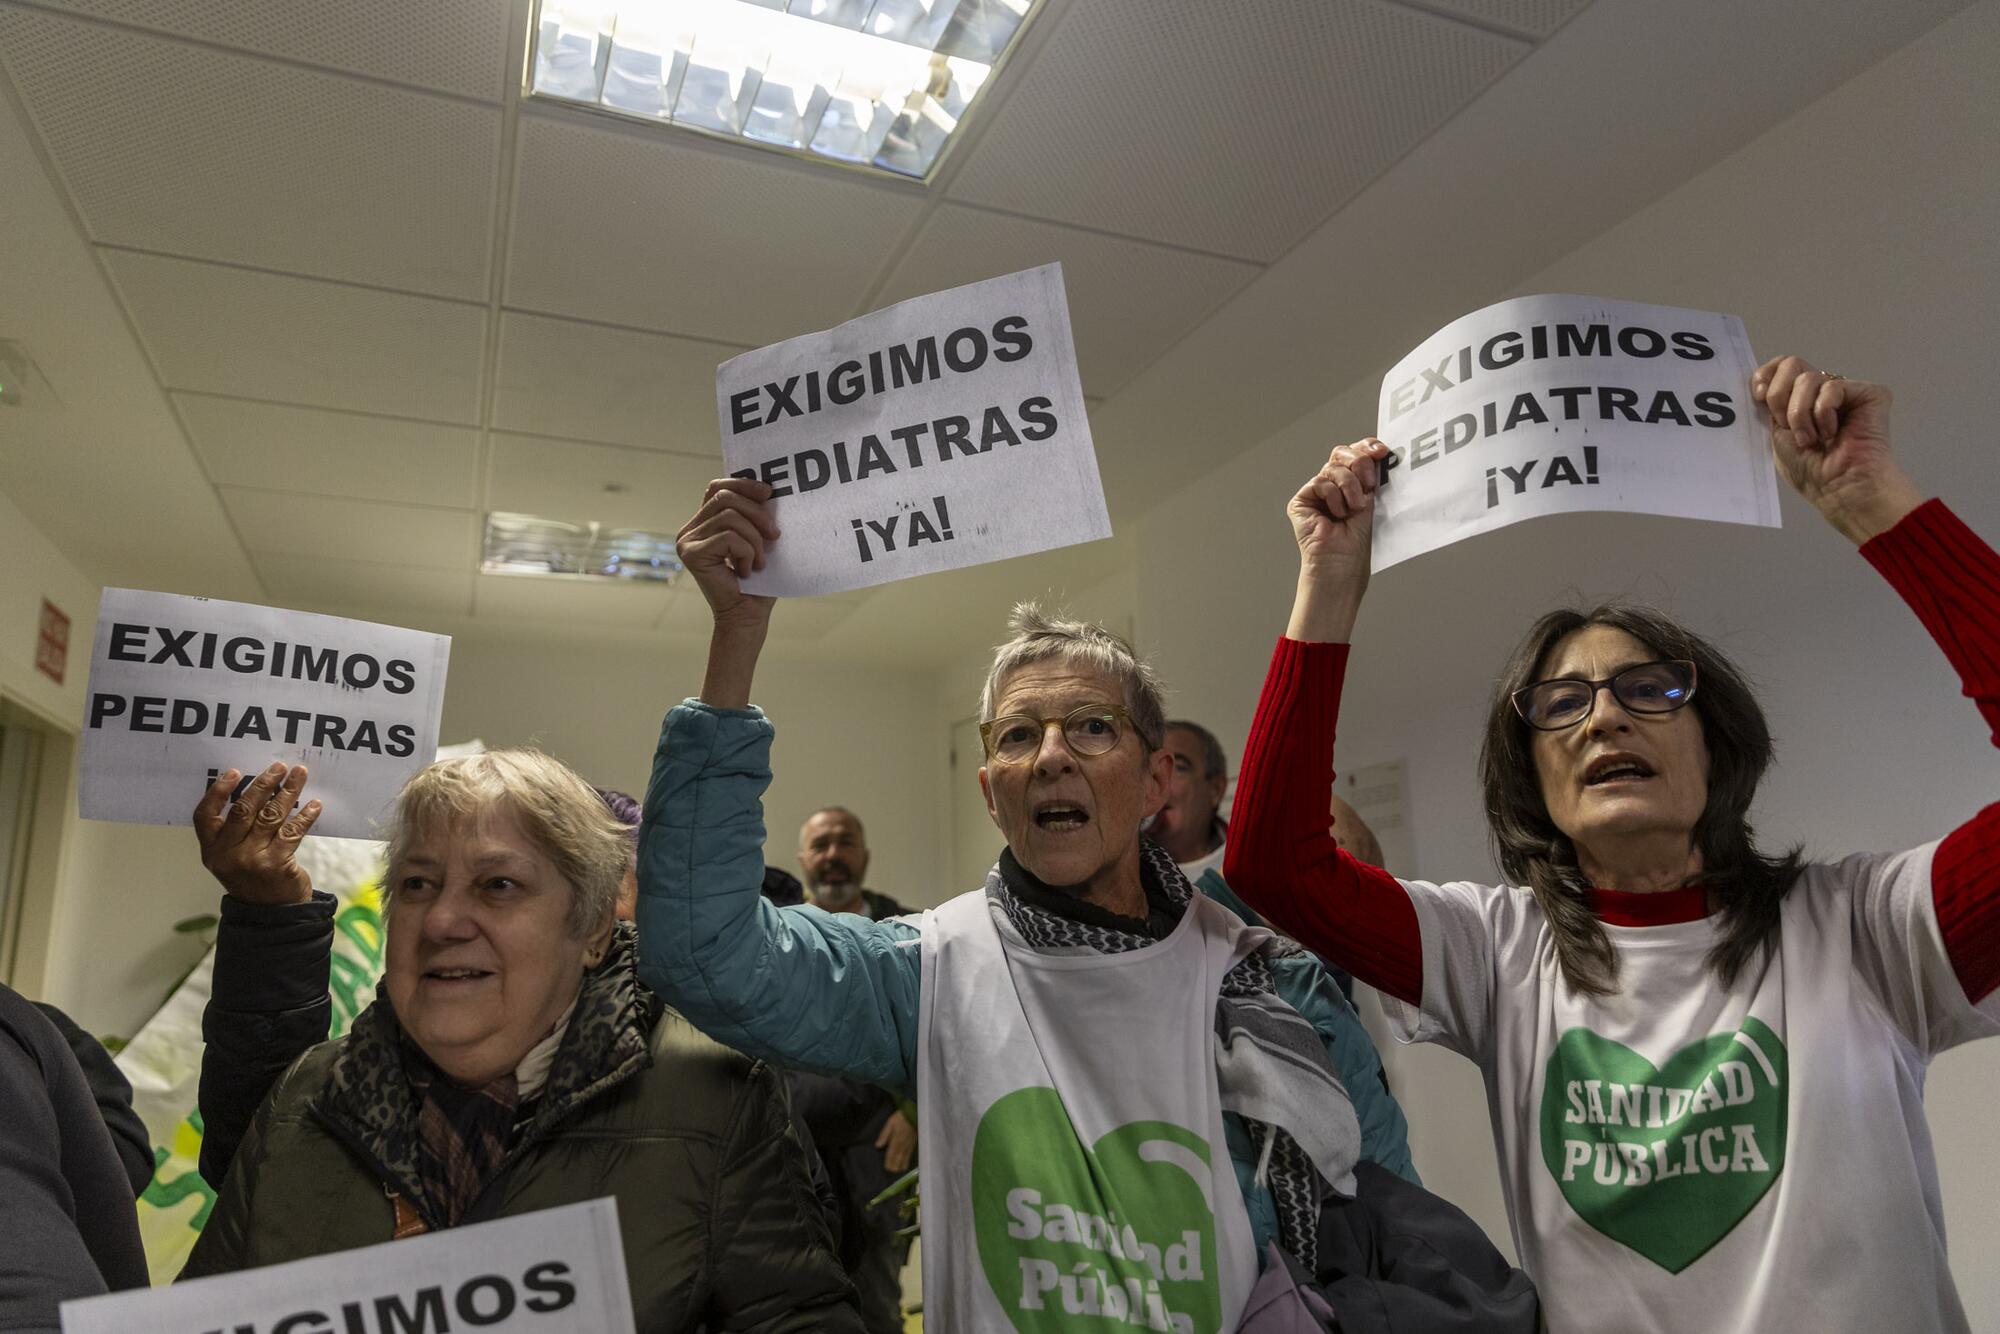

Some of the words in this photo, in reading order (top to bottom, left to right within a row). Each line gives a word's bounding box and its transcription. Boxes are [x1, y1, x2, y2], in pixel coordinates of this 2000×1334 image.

[730, 315, 1033, 435] EXIGIMOS
[1389, 323, 1715, 422] EXIGIMOS
[1379, 386, 1737, 487] PEDIATRAS
[1486, 446, 1600, 509] ¡YA!
[851, 496, 954, 563] ¡YA!
[108, 622, 416, 695] EXIGIMOS
[89, 692, 416, 758] PEDIATRAS
[1565, 1060, 1755, 1129] SANIDAD
[1562, 1124, 1770, 1187] PÚBLICA
[1018, 1256, 1195, 1334] Públi
